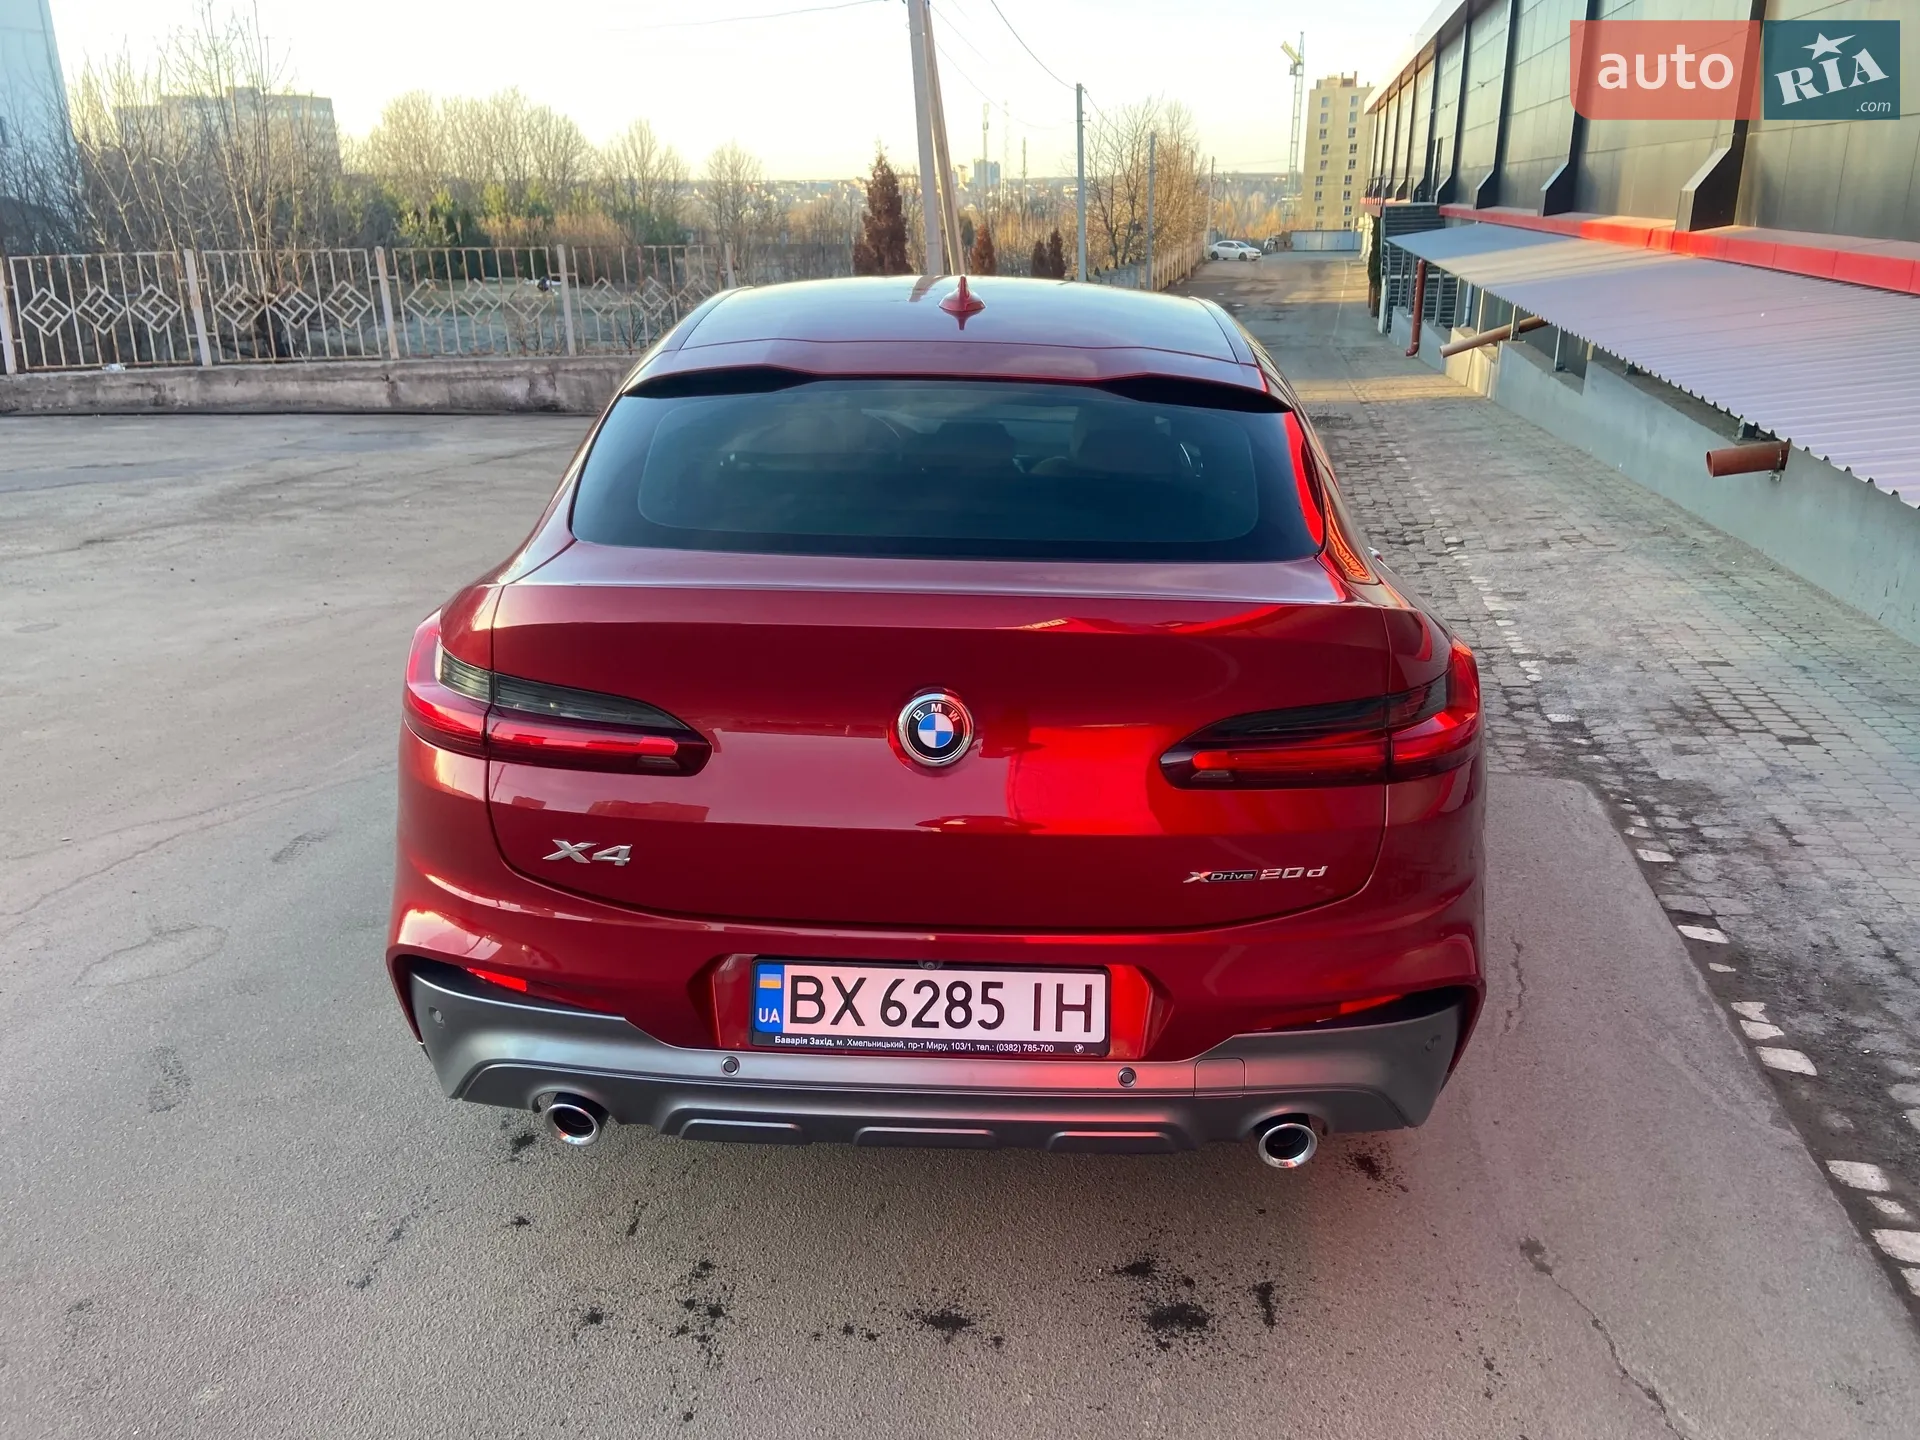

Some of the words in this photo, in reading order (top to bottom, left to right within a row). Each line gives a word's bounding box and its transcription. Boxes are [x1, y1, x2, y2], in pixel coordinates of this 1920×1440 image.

[912, 703, 960, 723] BMW
[542, 839, 633, 867] X4
[789, 975, 866, 1027] BX
[879, 978, 1005, 1030] 6285
[1032, 981, 1092, 1033] IH
[758, 1007, 780, 1024] UA
[774, 1036, 808, 1045] Баварія
[809, 1037, 835, 1046] Захід,
[847, 1038, 906, 1050] Хмельницький,
[908, 1042, 924, 1051] пр-т
[926, 1041, 949, 1051] Миру,
[951, 1043, 974, 1051] 103/1,
[996, 1043, 1021, 1053] (0382)
[1023, 1044, 1054, 1053] 785-700
